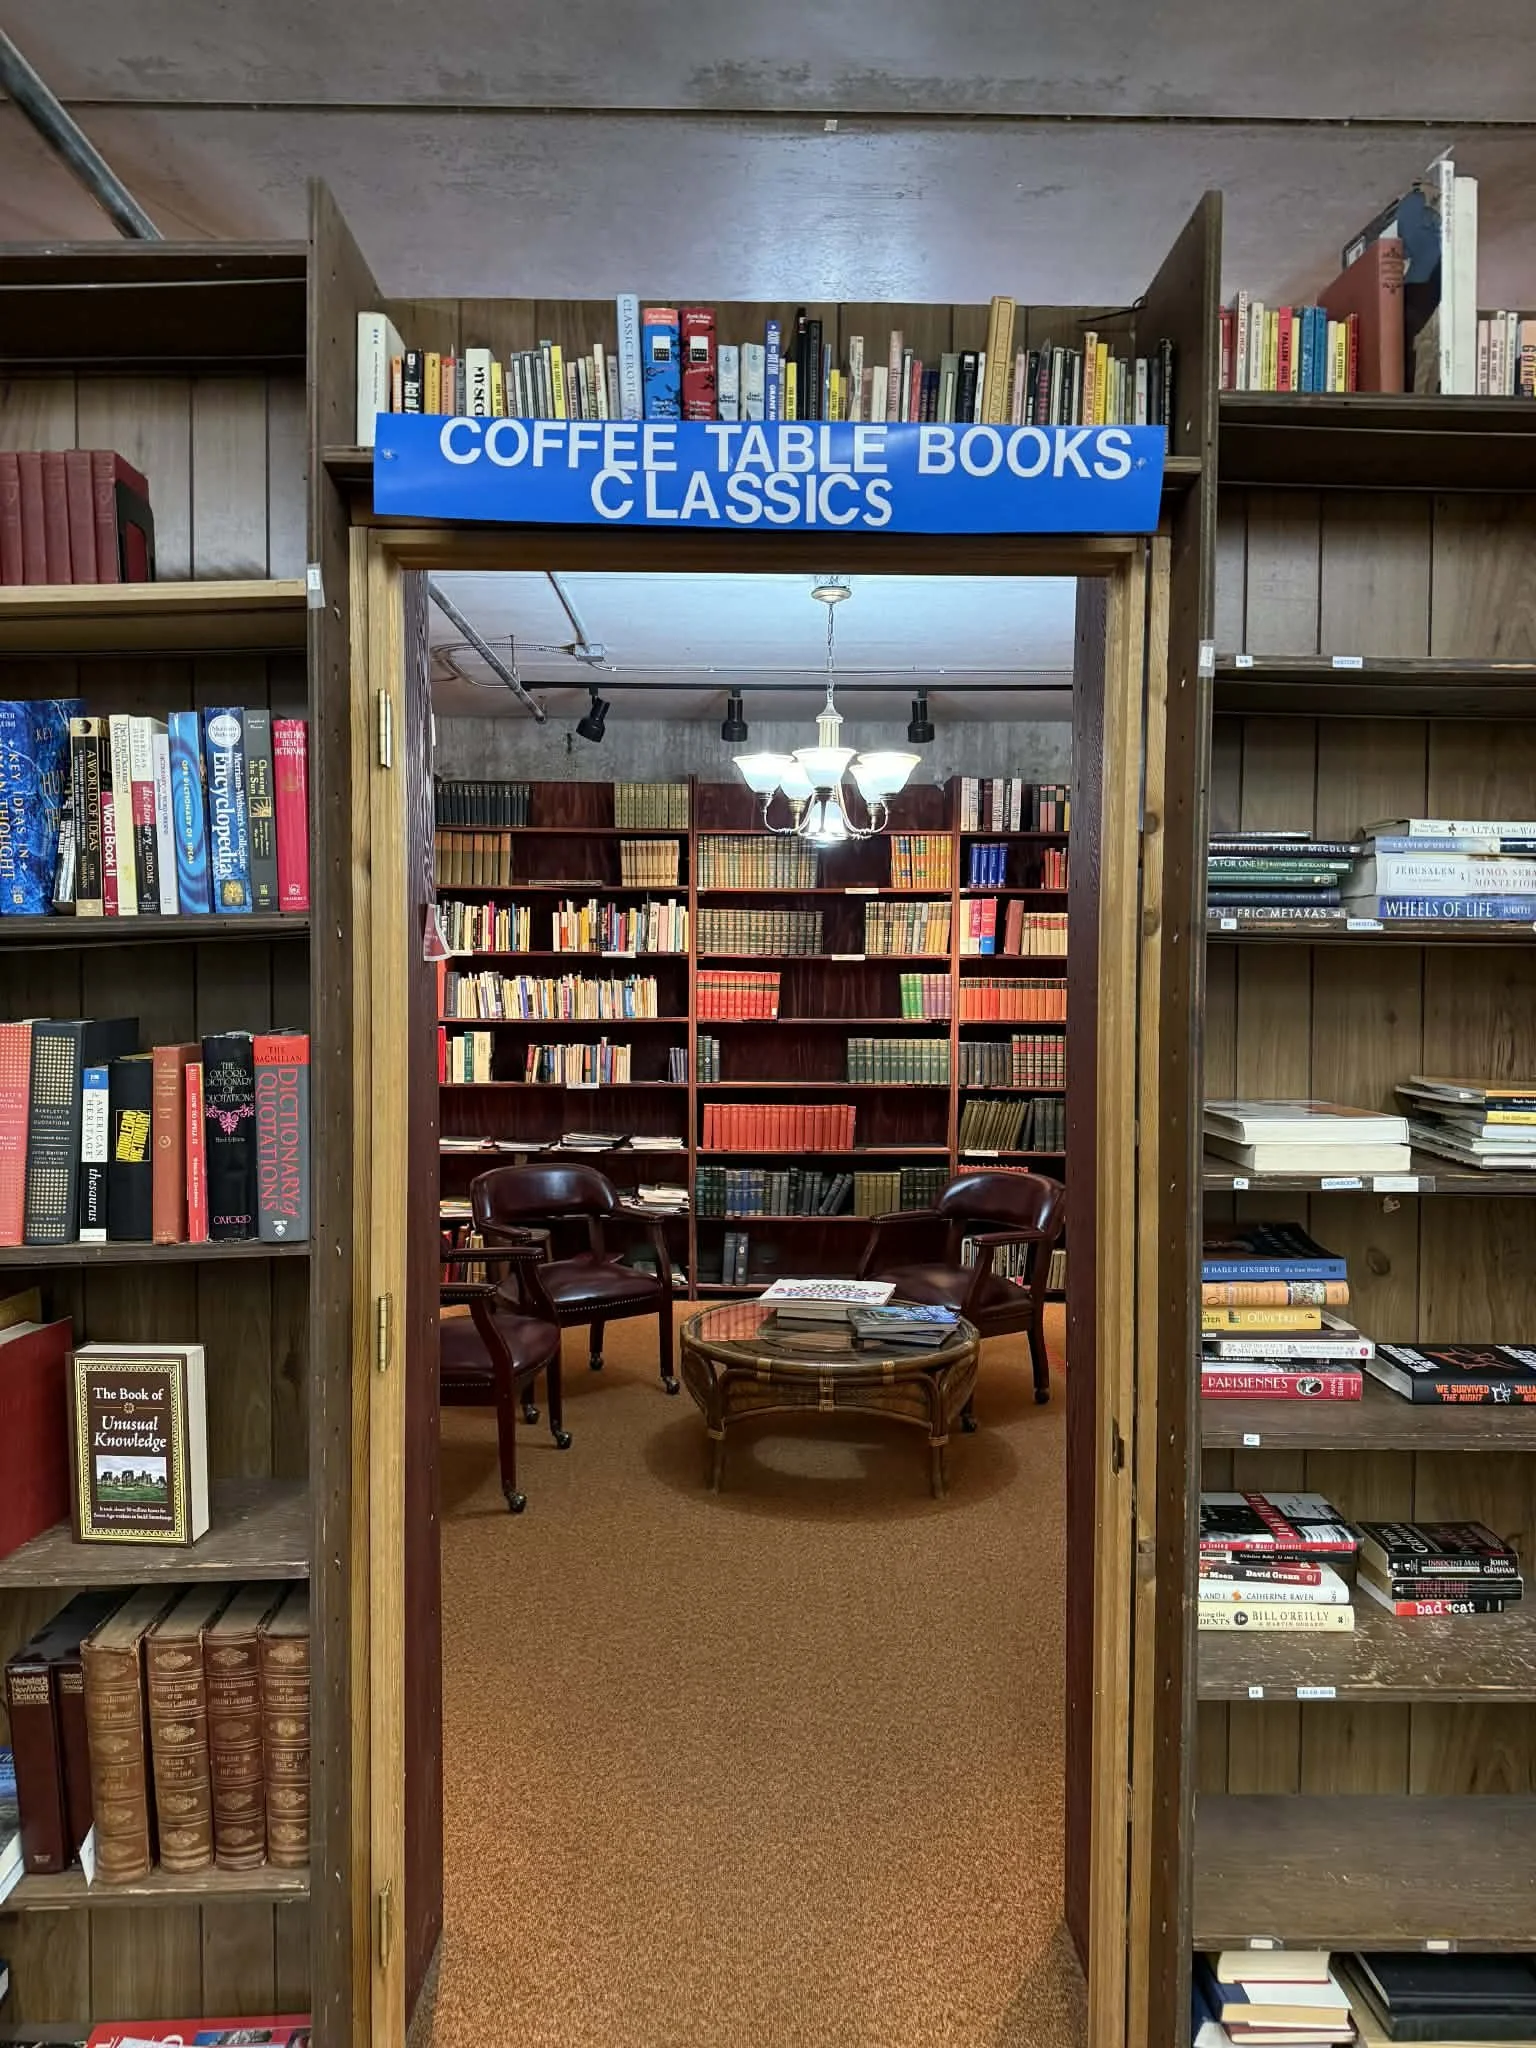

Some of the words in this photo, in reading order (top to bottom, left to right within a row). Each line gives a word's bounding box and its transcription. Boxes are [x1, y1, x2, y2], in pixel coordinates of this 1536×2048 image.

[622, 299, 634, 347] CLASSIC
[1281, 331, 1289, 362] FALLEN
[473, 366, 485, 385] MY
[624, 353, 637, 401] EROTIC
[404, 381, 419, 398] Act
[769, 384, 777, 410] GRANT
[439, 416, 678, 473] COFFEE
[705, 423, 888, 474] TABLE
[918, 425, 1133, 481] BOOKS
[590, 469, 893, 527] CLASSICS
[86, 750, 97, 758] A
[8, 753, 22, 782] KEY
[86, 758, 98, 801] WORLD
[249, 776, 260, 795] Sun
[257, 759, 267, 795] Chasing
[233, 752, 246, 826] Merriam-Webster's
[87, 802, 98, 819] OF
[182, 777, 193, 827] DICTIONARY
[13, 791, 27, 835] IDEAS
[103, 803, 116, 832] Word
[209, 751, 236, 875] Encyclopedia
[0, 799, 15, 880] THOUGHT
[87, 820, 99, 852] IDEAS
[18, 842, 29, 859] IN
[104, 833, 117, 865] Book
[236, 828, 248, 869] Collegiate
[106, 866, 117, 877] II
[144, 851, 155, 884] IDIOMS
[1238, 859, 1257, 868] ONE
[1395, 865, 1457, 875] JERUSALEM
[1475, 868, 1509, 876] SIMON
[1236, 907, 1266, 919] ERIC
[1269, 907, 1327, 919] METAXAS
[1385, 900, 1440, 918] WHEELS
[1442, 901, 1461, 918] OF
[1465, 902, 1493, 918] LIFE
[1502, 905, 1531, 915] JUDITH
[255, 1054, 303, 1064] MACMILLAN
[267, 1046, 286, 1055] THE
[209, 1069, 247, 1079] OXFORD
[220, 1062, 235, 1071] THE
[206, 1077, 253, 1087] DICTIONARY
[222, 1086, 235, 1095] OF
[206, 1093, 255, 1103] QUOTATIONS
[85, 1099, 95, 1160] HERITAGE
[96, 1099, 105, 1157] AMERICAN
[116, 1110, 136, 1161] DOUBLEDAY
[129, 1110, 151, 1163] DICTIONARY
[277, 1067, 300, 1201] DICTIONARY
[257, 1072, 279, 1211] QUOTATIONS
[87, 1167, 102, 1223] thesaurus
[213, 1214, 251, 1225] OXFORD
[1207, 1377, 1288, 1390] PARISIENNES
[1435, 1384, 1449, 1394] WE
[1450, 1384, 1490, 1394] SURVIVED
[1514, 1384, 1536, 1394] JULIA
[93, 1387, 117, 1400] The
[119, 1387, 149, 1401] Book
[151, 1388, 165, 1401] of
[1441, 1394, 1458, 1402] THE
[1459, 1394, 1484, 1402] NIGHT
[102, 1414, 159, 1432] Unusual
[93, 1432, 167, 1453] Knowledge
[1428, 1559, 1464, 1567] INNOCENT
[1464, 1559, 1480, 1567] MAN
[1483, 1566, 1516, 1574] GRISHAM
[1489, 1558, 1510, 1567] JOHN
[1209, 1571, 1234, 1580] Moon
[1245, 1569, 1272, 1579] David
[1272, 1570, 1301, 1581] Grann
[1246, 1592, 1287, 1601] CATHERINE
[1289, 1593, 1315, 1601] RAVEN
[1252, 1610, 1279, 1622] BILL
[1279, 1610, 1330, 1622] O'REILLY
[1414, 1602, 1443, 1616] bad
[1451, 1601, 1476, 1614] cat
[10, 1675, 49, 1686] Webster's
[12, 1692, 49, 1702] Dictionary
